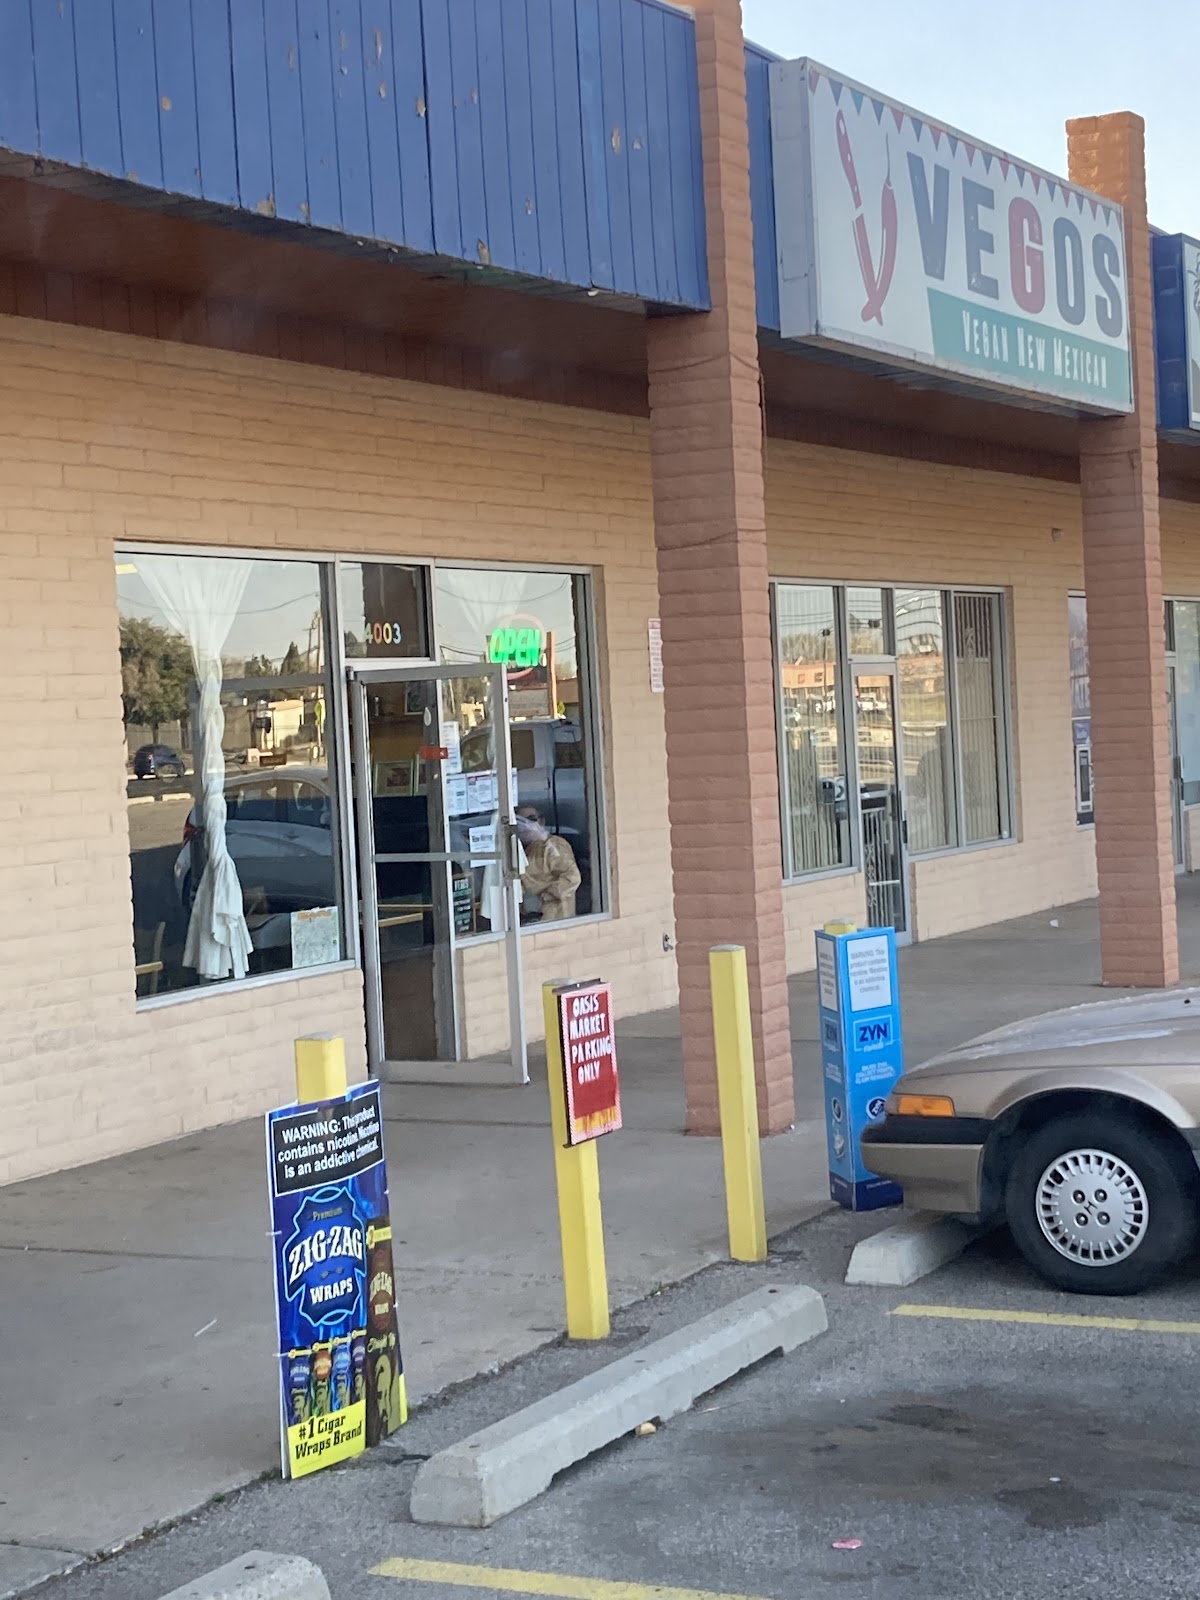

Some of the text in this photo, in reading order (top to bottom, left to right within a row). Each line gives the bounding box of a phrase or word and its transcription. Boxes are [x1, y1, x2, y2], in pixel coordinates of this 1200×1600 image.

[907, 151, 1122, 338] VEGOS
[364, 622, 401, 645] 4003
[489, 628, 541, 667] OPEN
[572, 993, 599, 1017] OASIS
[570, 1013, 606, 1040] MARKET
[859, 1022, 888, 1042] ZYN
[572, 1035, 612, 1064] PARKING
[578, 1060, 601, 1085] ONLY
[282, 1119, 341, 1143] WARNING:
[278, 1142, 325, 1162] contains
[284, 1165, 295, 1178] is
[298, 1163, 311, 1175] an
[314, 1149, 355, 1172] addictive
[313, 1207, 343, 1221] Premium
[289, 1226, 363, 1285] ZIG-ZAG
[310, 1277, 353, 1305] WRAPS
[295, 1419, 363, 1459] Wraps Brand
[298, 1415, 346, 1440] #1 Cigar
